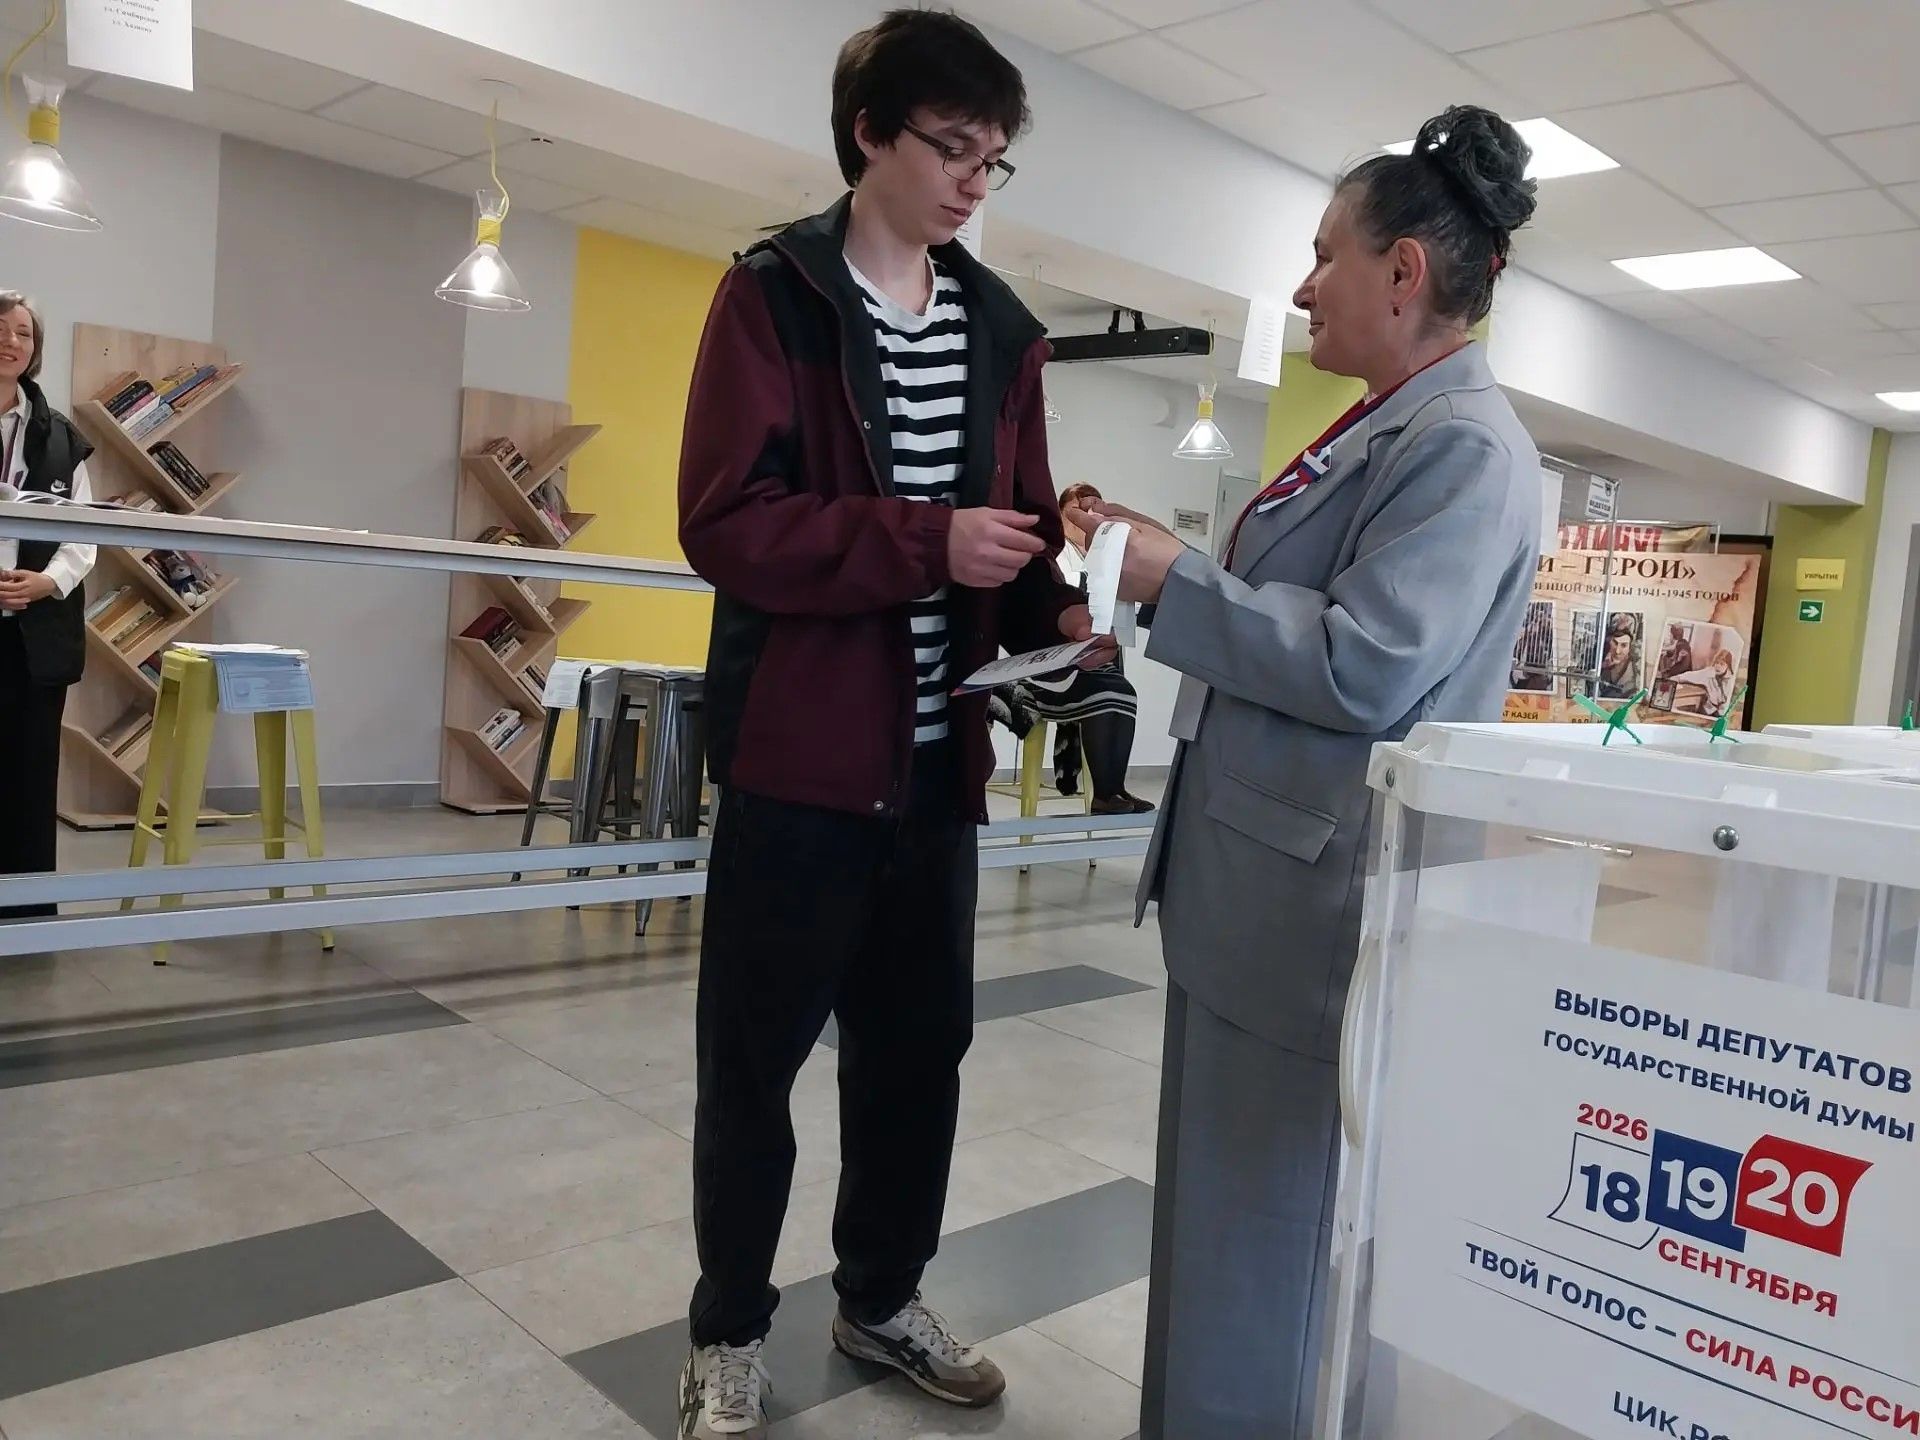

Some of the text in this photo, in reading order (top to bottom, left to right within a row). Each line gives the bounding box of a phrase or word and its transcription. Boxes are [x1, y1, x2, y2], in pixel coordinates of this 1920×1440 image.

[1584, 555, 1696, 580] ГЕРОИ»
[1586, 584, 1633, 596] ВОНЫ
[1636, 587, 1692, 599] 1941-1945
[1695, 591, 1741, 602] ГОДОВ
[1511, 711, 1539, 721] КАЗЕЙ
[1555, 988, 1912, 1094] ВЫБОРЫ ДЕПУТАТОВ
[1543, 1029, 1915, 1142] ГОСУДАРСТВЕННОЙ ДУМЫ
[1577, 1103, 1649, 1141] 2026
[1580, 1158, 1840, 1227] 18 19 20
[1658, 1238, 1838, 1318] СЕНТЯБРЯ
[1465, 1242, 1539, 1289] ТВОЙ
[1546, 1273, 1647, 1330] ГОЛОС
[1685, 1328, 1777, 1382] СИЛА
[1612, 1390, 1732, 1440] ЦИК.Р
